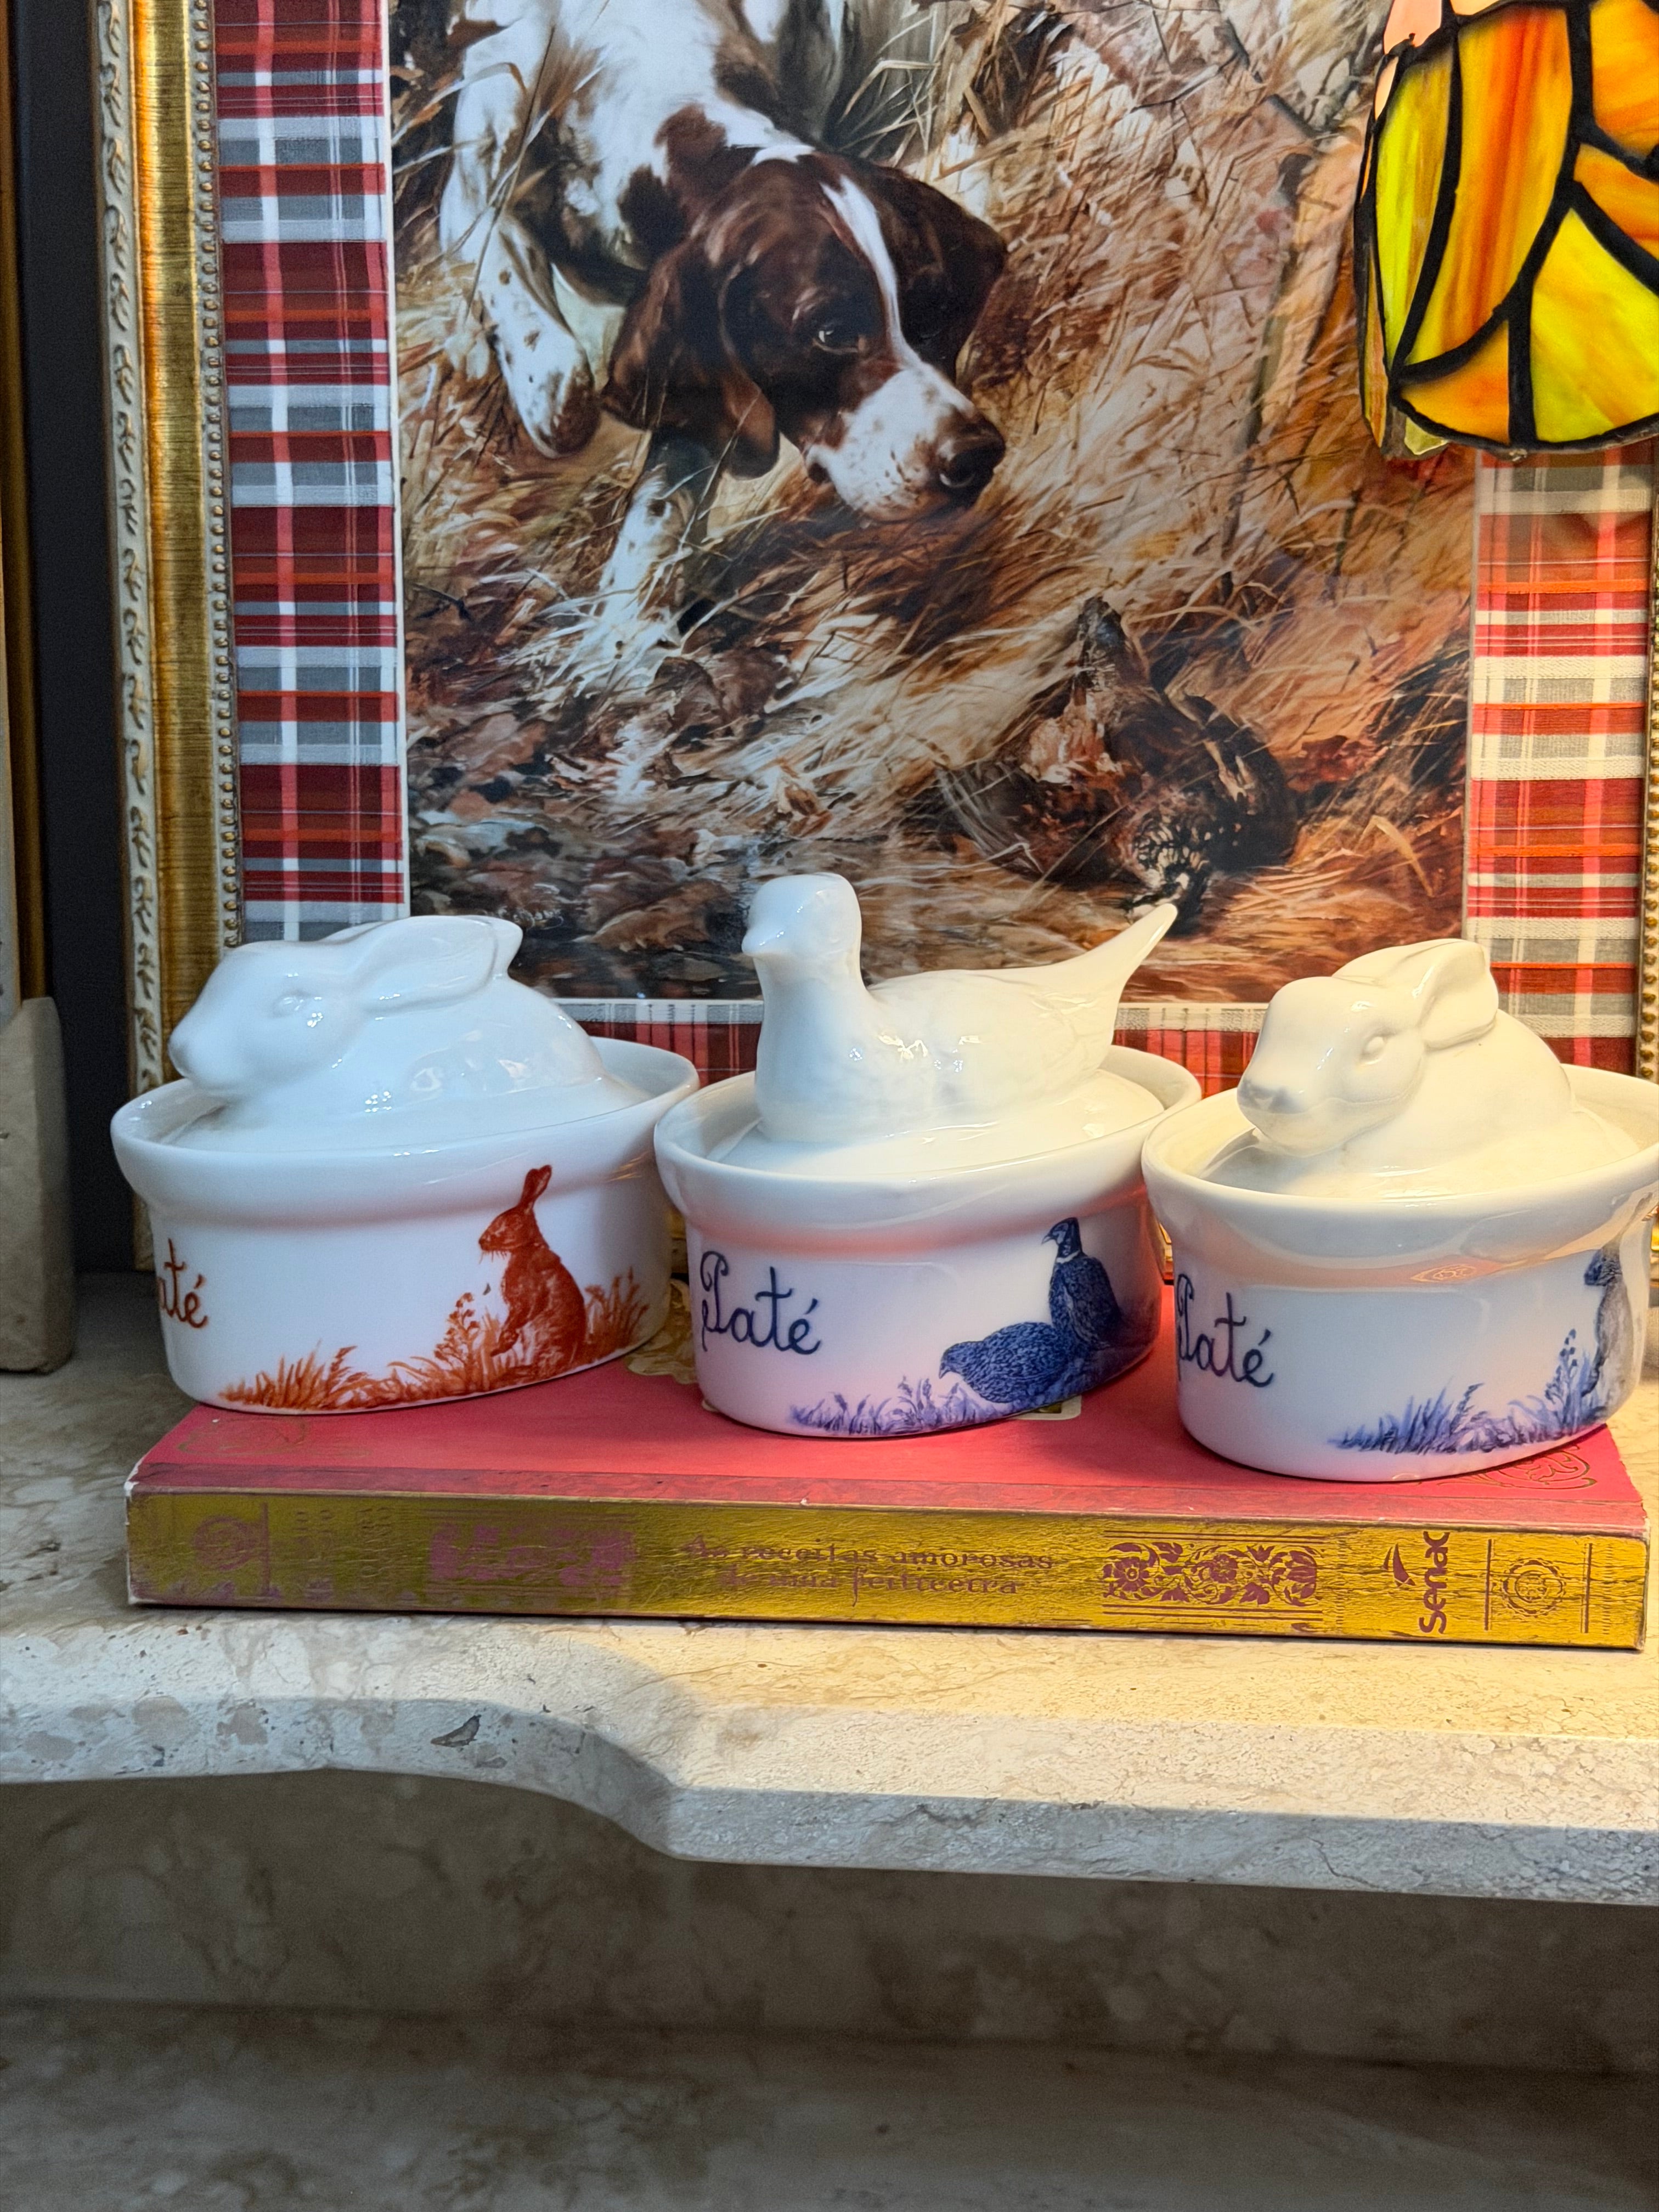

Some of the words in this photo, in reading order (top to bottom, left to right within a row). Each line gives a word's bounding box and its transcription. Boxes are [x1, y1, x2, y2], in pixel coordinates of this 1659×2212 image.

[157, 1238, 209, 1329] até
[699, 1250, 821, 1355] Paté
[1177, 1273, 1274, 1387] Paté
[742, 1538, 877, 1564] receitas
[890, 1550, 1052, 1569] amorosas
[851, 1567, 1022, 1607] feiticeira
[1419, 1531, 1449, 1633] Senac
